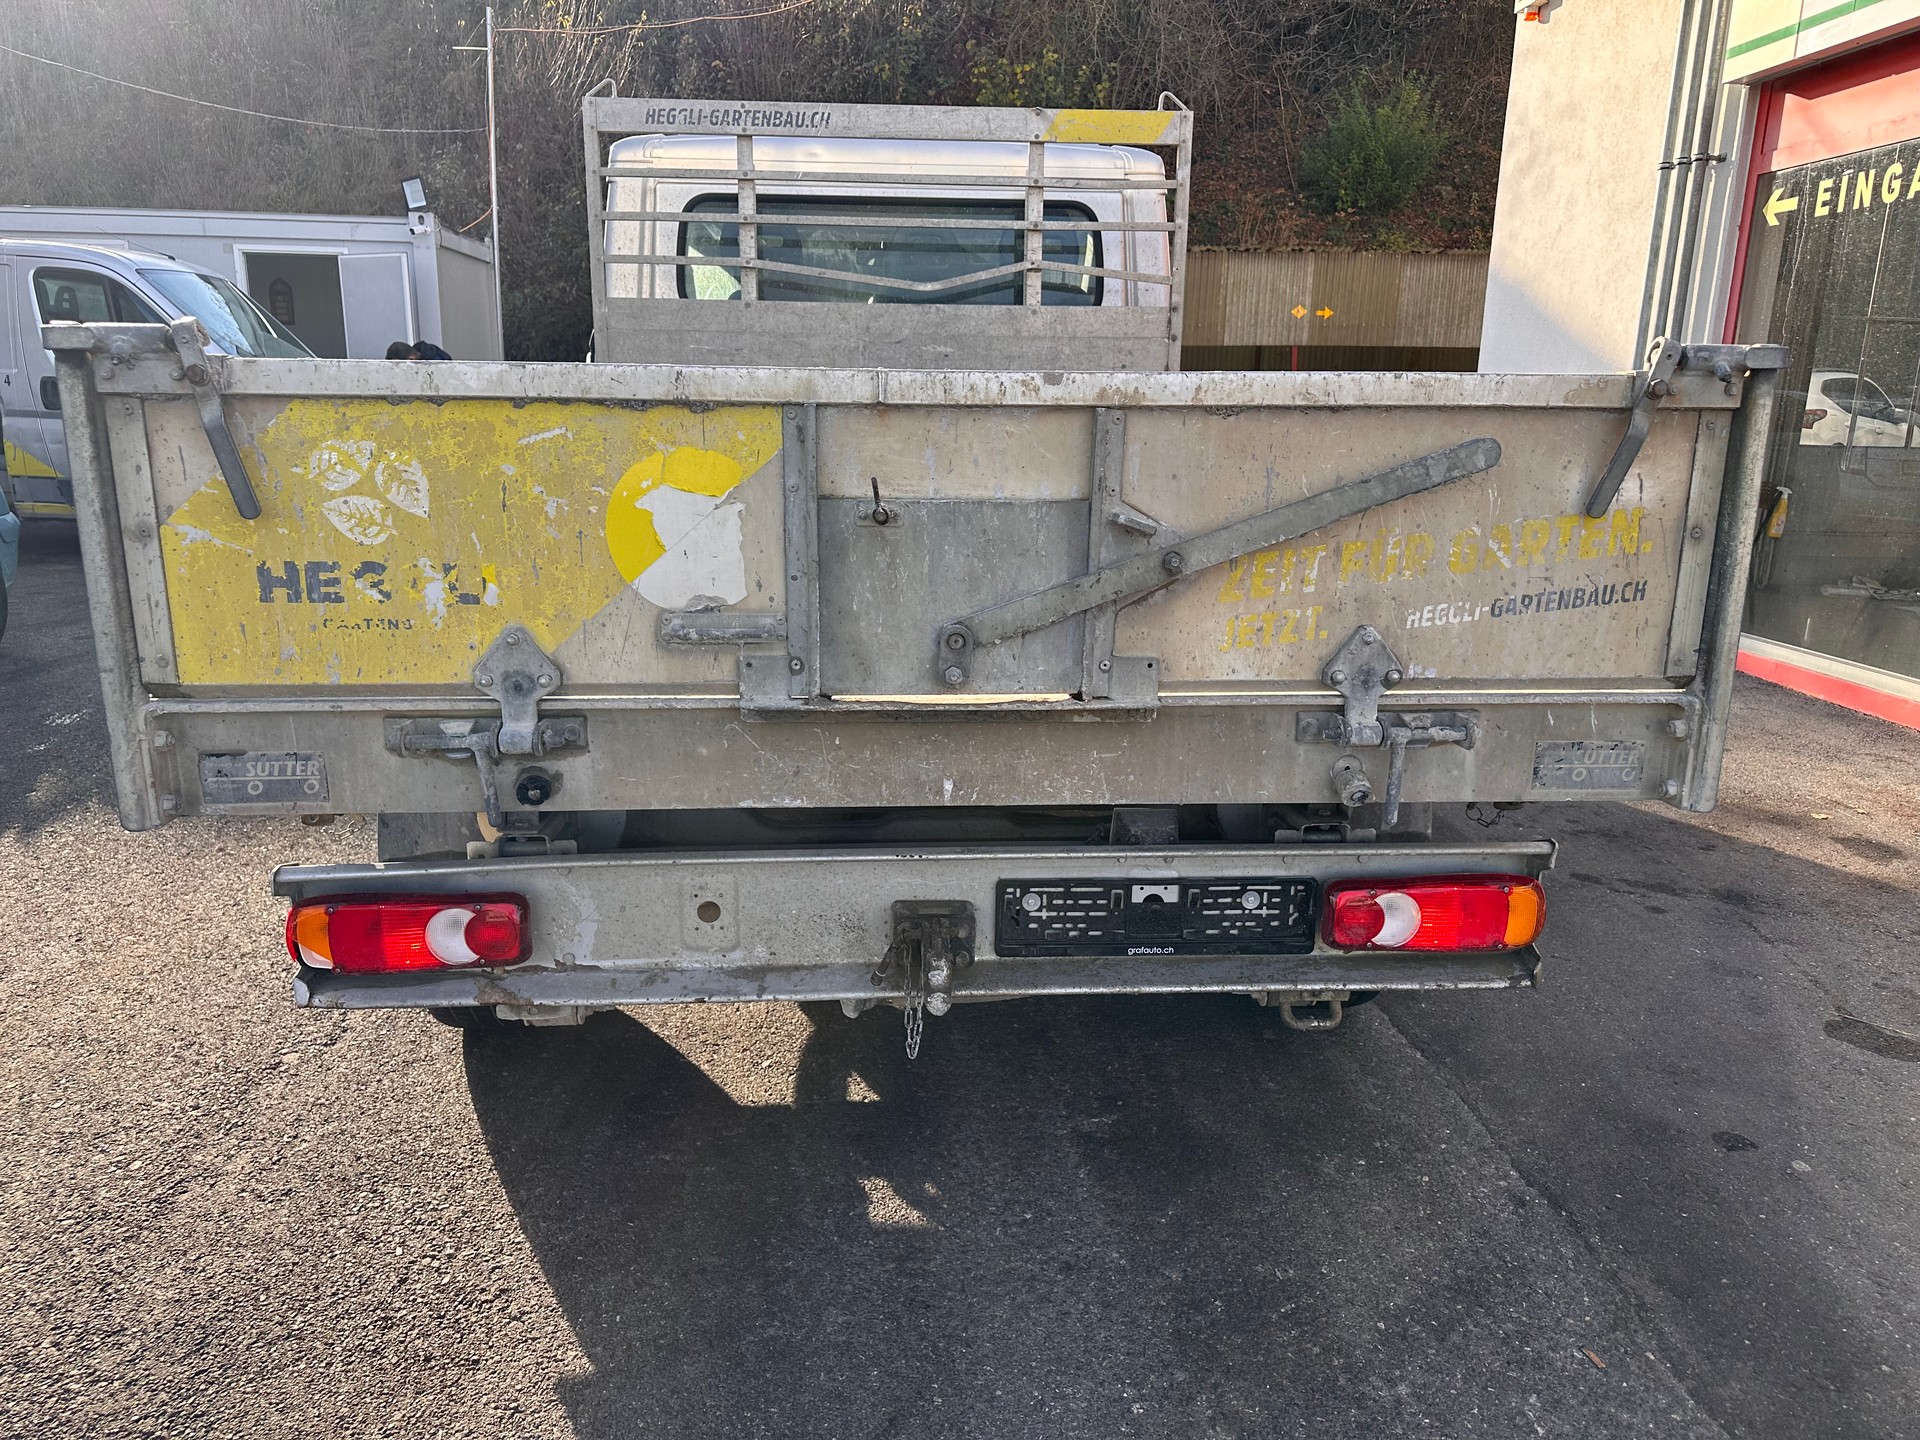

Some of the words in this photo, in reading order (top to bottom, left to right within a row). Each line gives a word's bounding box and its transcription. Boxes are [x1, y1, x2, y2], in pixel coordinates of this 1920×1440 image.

[1218, 544, 1327, 603] ZEIT
[1338, 526, 1436, 588] FÜR
[1449, 507, 1653, 574] GARTEN.
[1219, 605, 1328, 651] JETZT.
[245, 760, 320, 776] SUTTER
[1127, 946, 1174, 956] grafauto.ch
